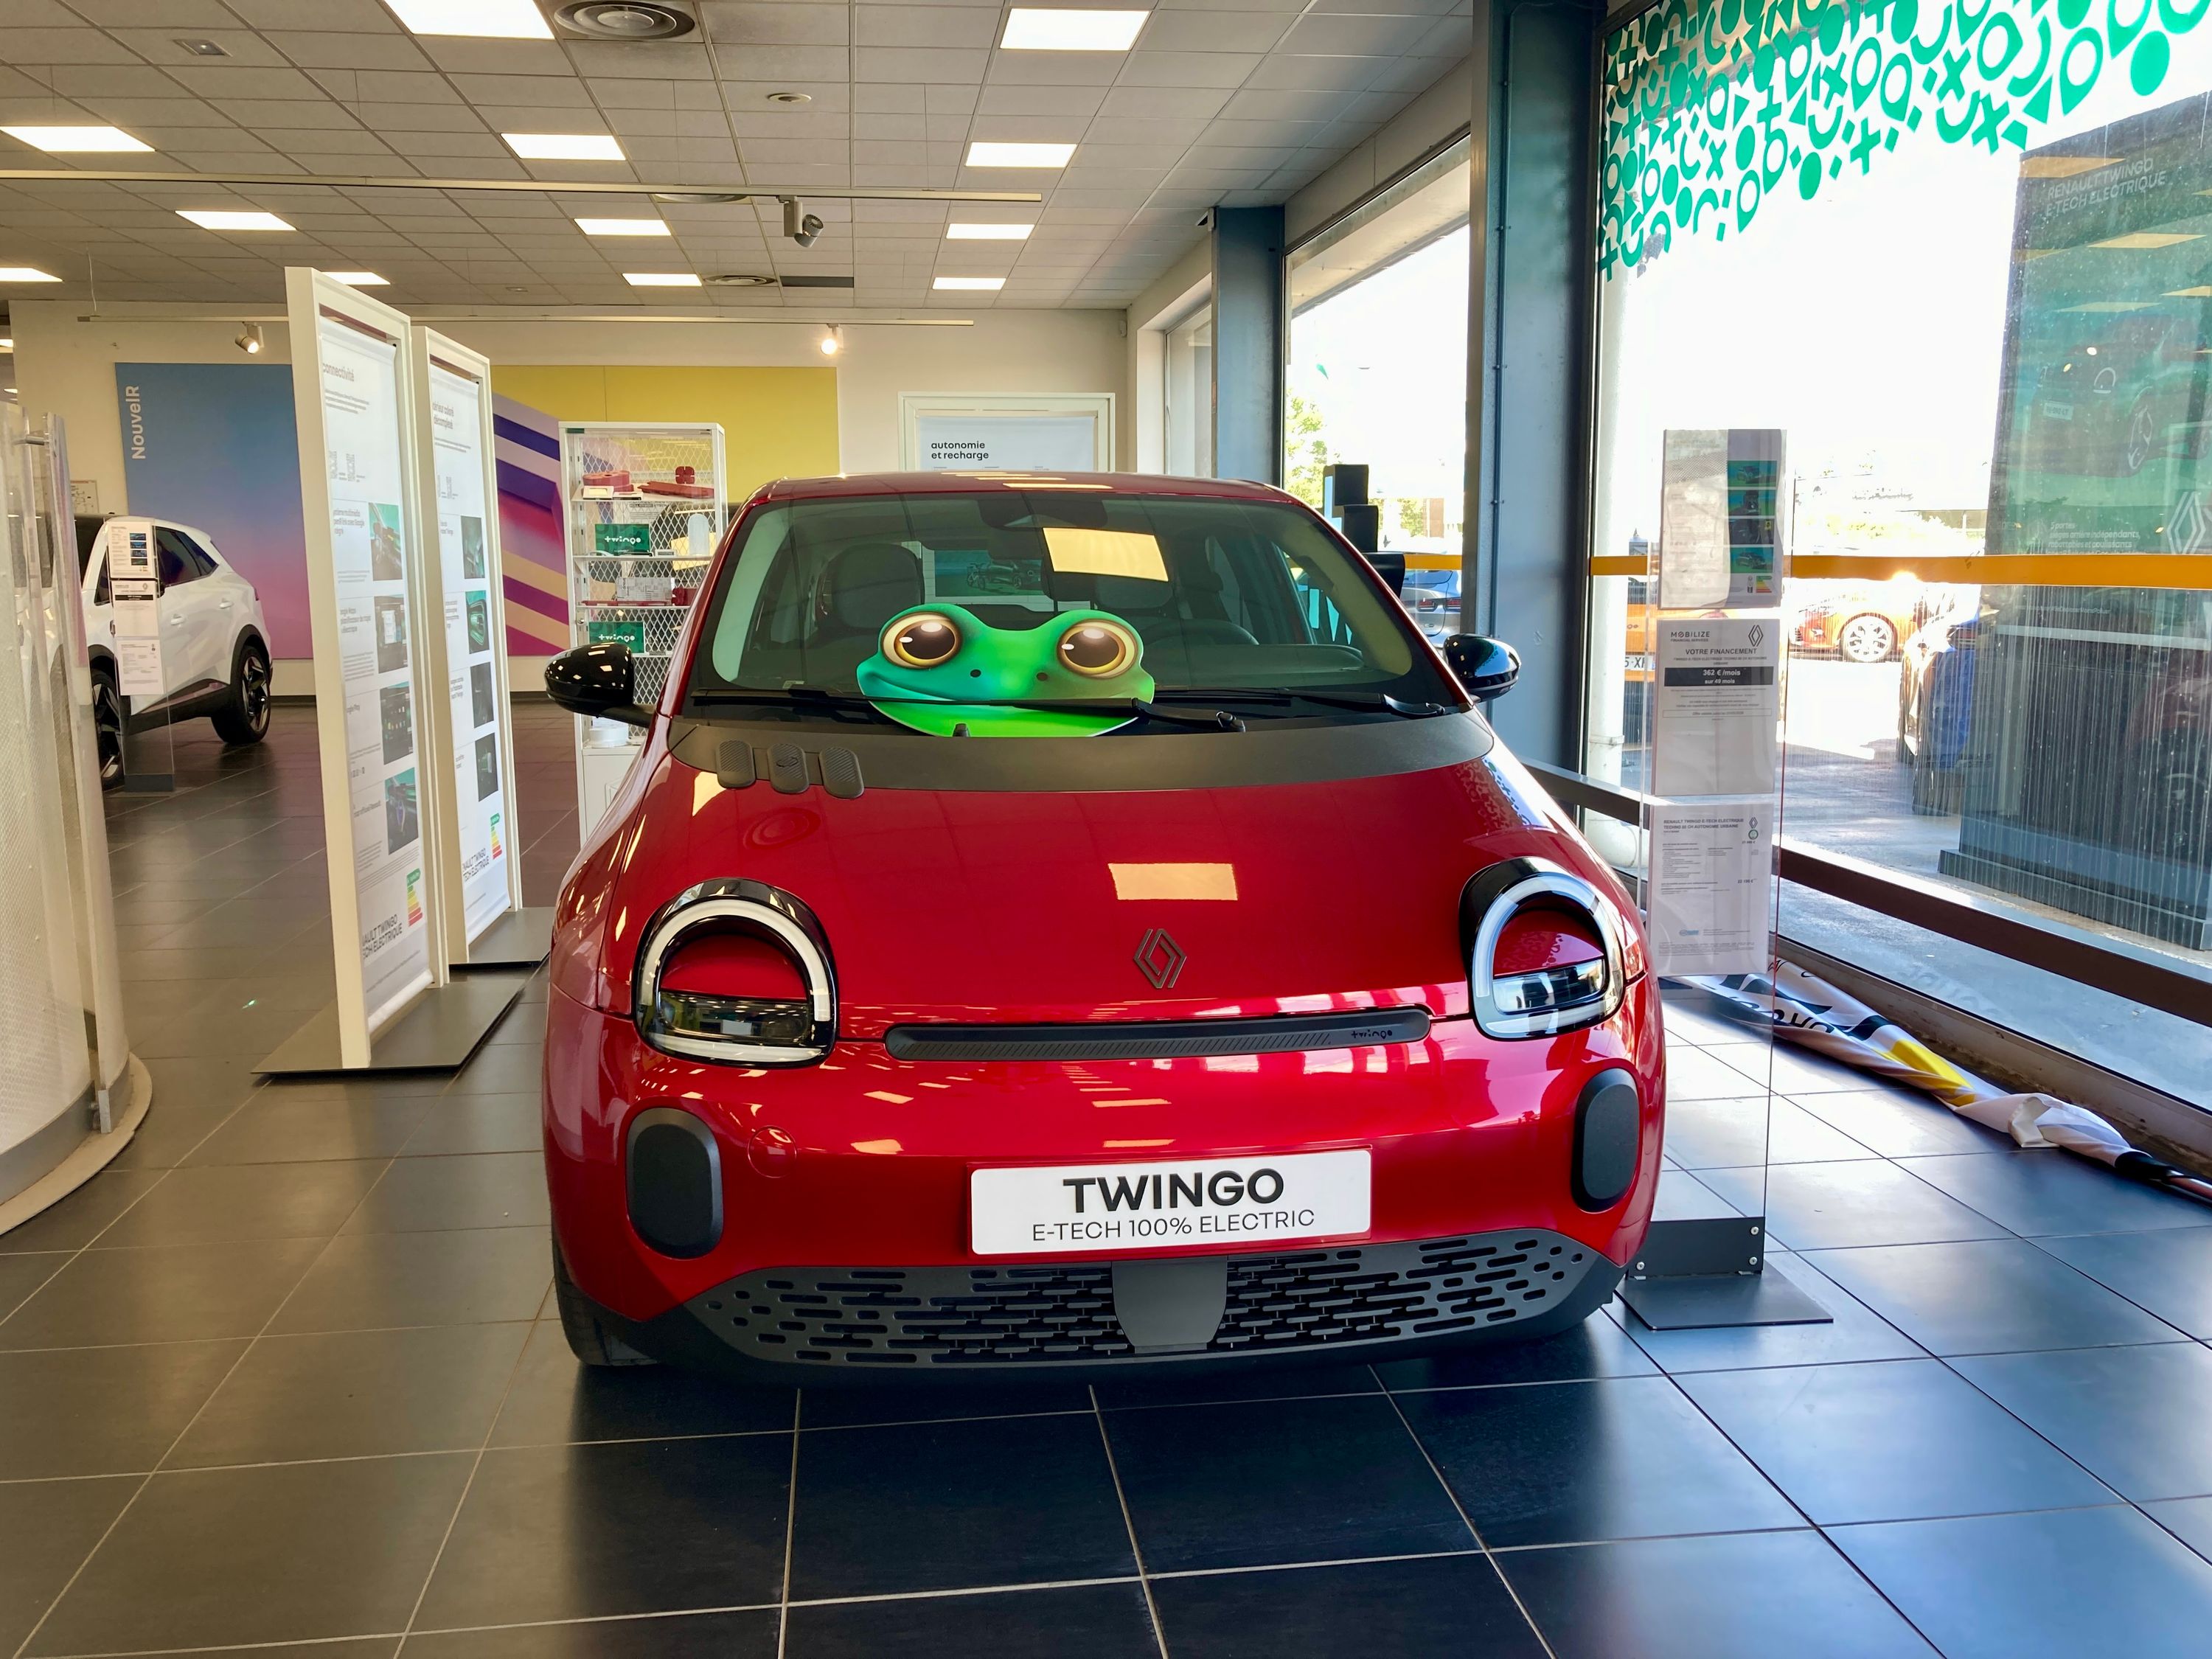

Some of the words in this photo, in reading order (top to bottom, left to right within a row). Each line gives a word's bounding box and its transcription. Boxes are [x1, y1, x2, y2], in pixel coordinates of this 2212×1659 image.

[2048, 172, 2101, 201] RENAULT
[2102, 158, 2153, 183] TWINGO
[2045, 193, 2087, 217] E-TECH
[2088, 170, 2166, 204] ELECTRIQUE
[931, 440, 985, 449] autonomie
[944, 451, 989, 461] recharge
[605, 536, 641, 545] twingo
[599, 634, 636, 643] twingo
[1351, 1029, 1393, 1040] twingo
[1063, 1168, 1284, 1213] TWINGO
[1032, 1220, 1121, 1242] E-TECH
[1129, 1216, 1192, 1237] 100%
[1200, 1208, 1315, 1233] ELECTRIC
